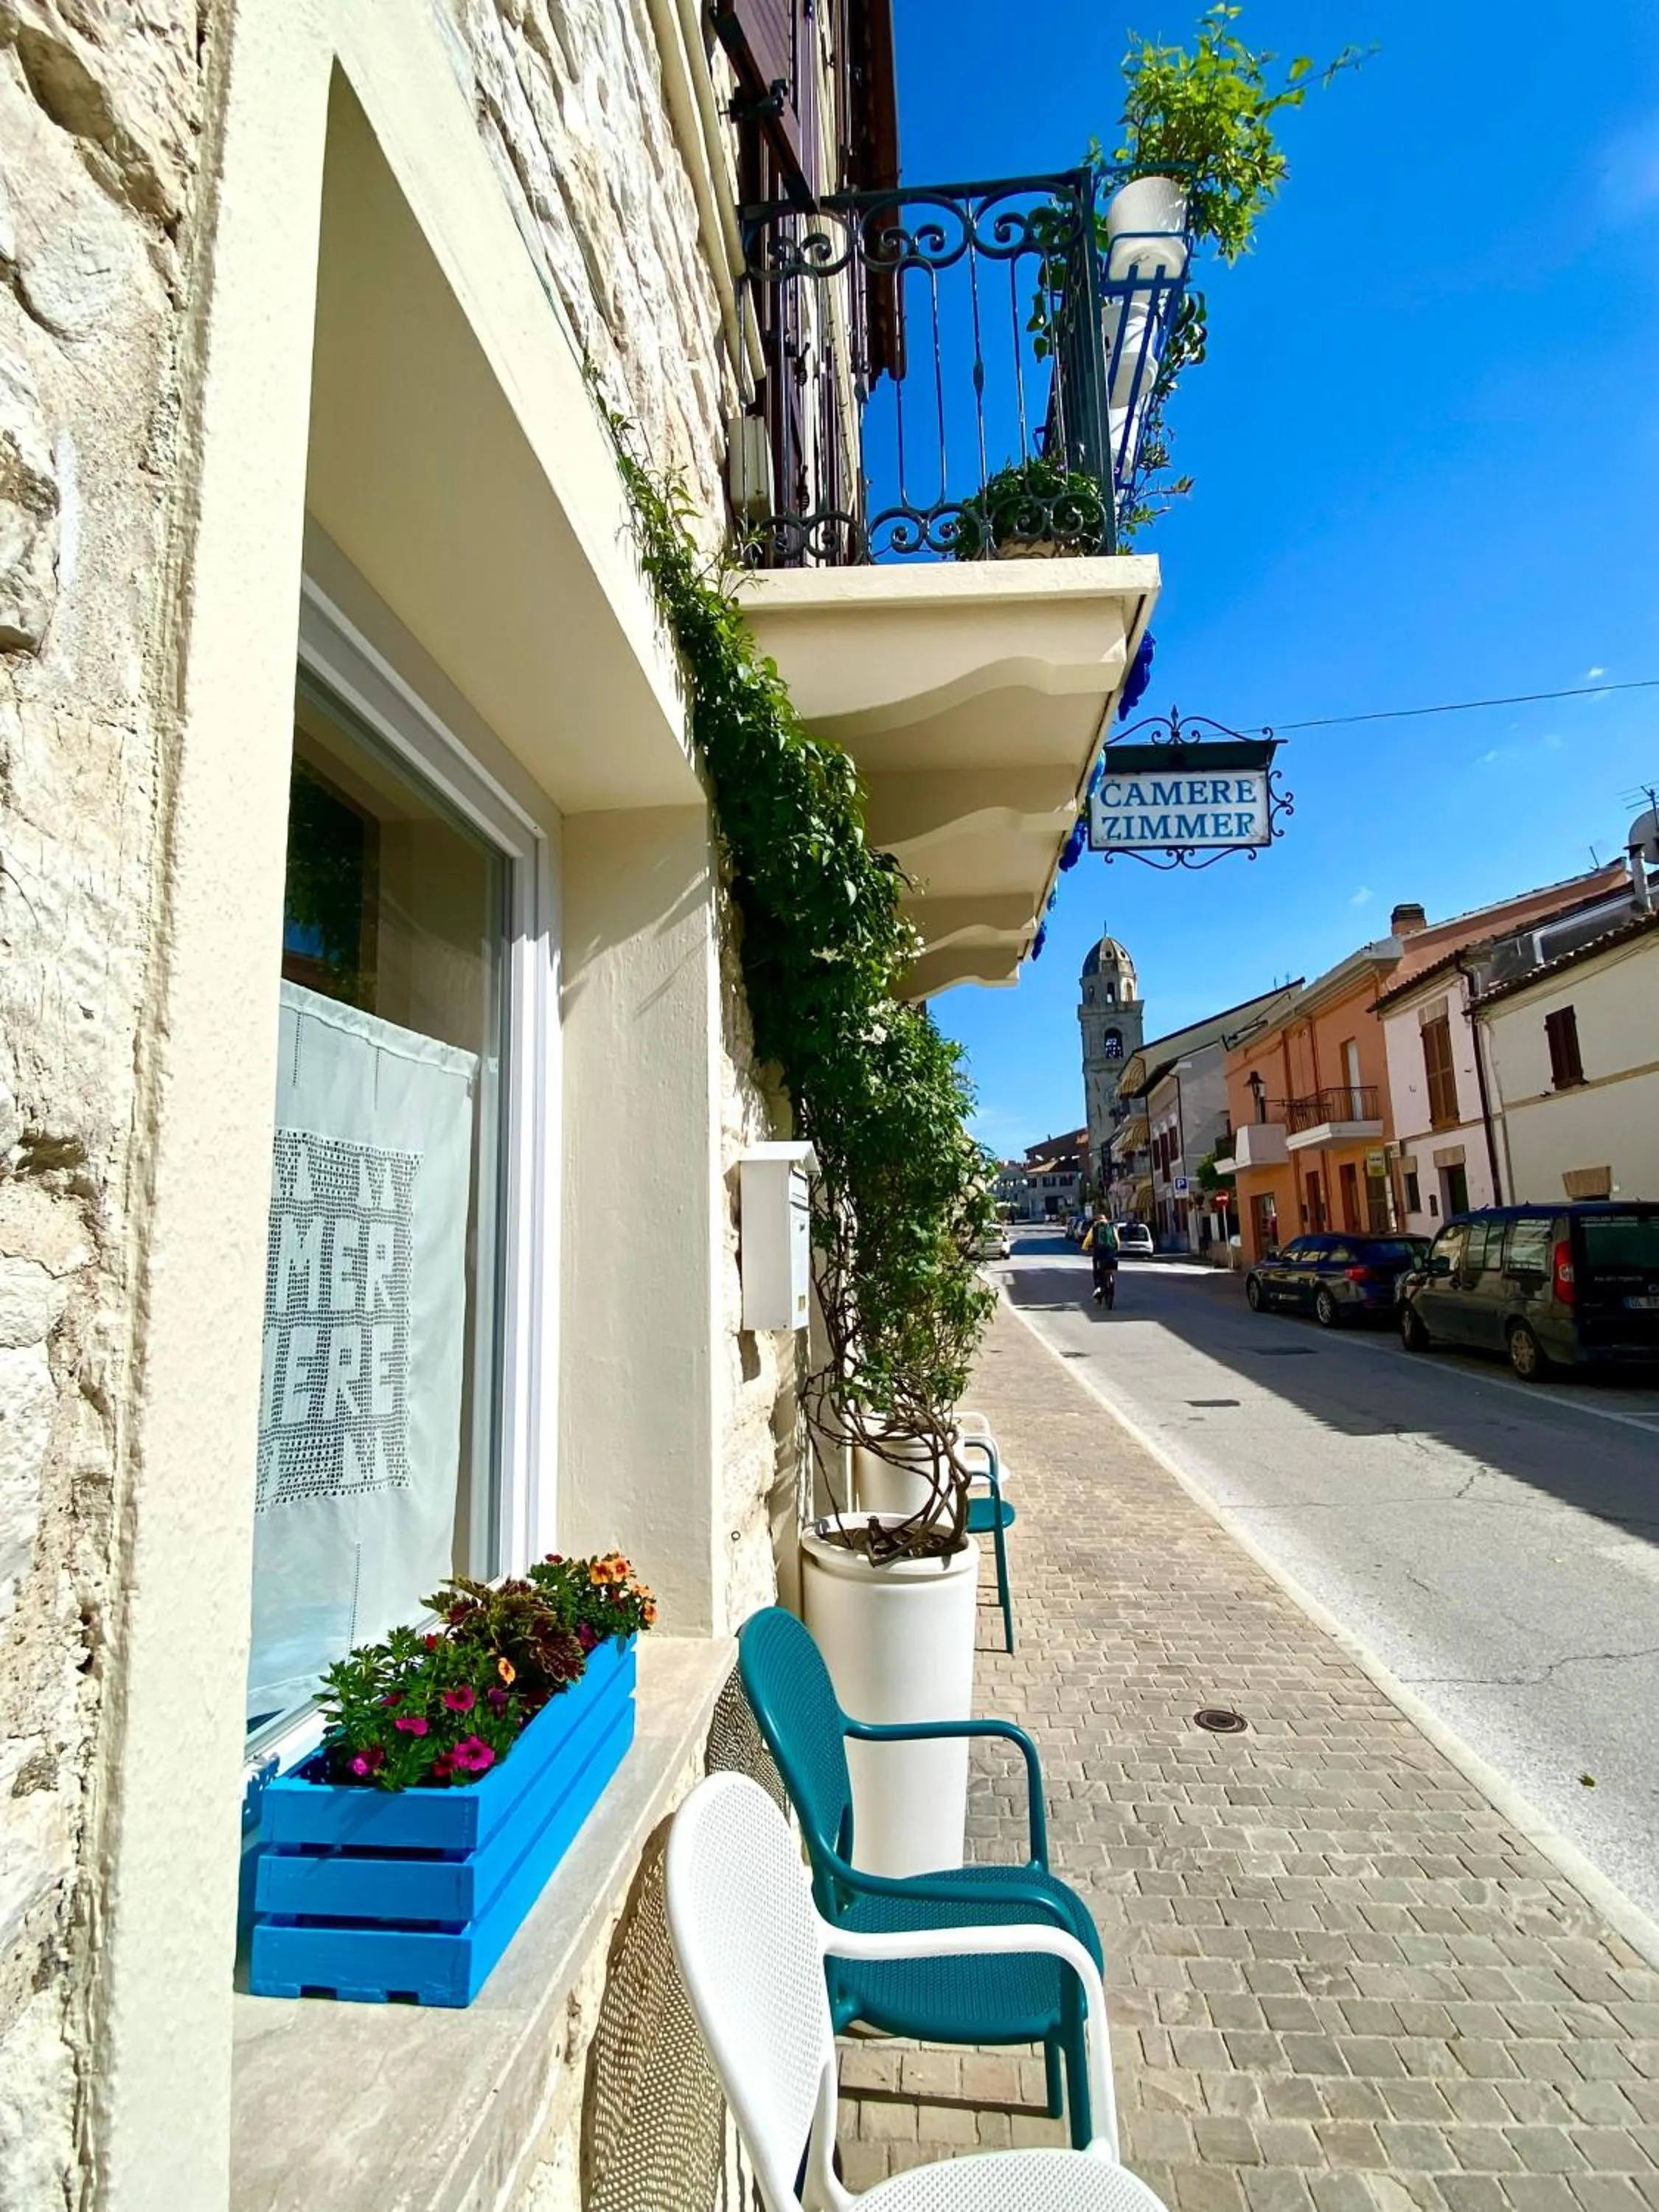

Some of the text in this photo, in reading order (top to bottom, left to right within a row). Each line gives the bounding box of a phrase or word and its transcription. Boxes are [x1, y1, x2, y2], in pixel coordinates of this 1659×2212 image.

[1100, 779, 1256, 807] CAMERE
[1102, 813, 1256, 841] ZIMMER
[1177, 1179, 1185, 1189] P
